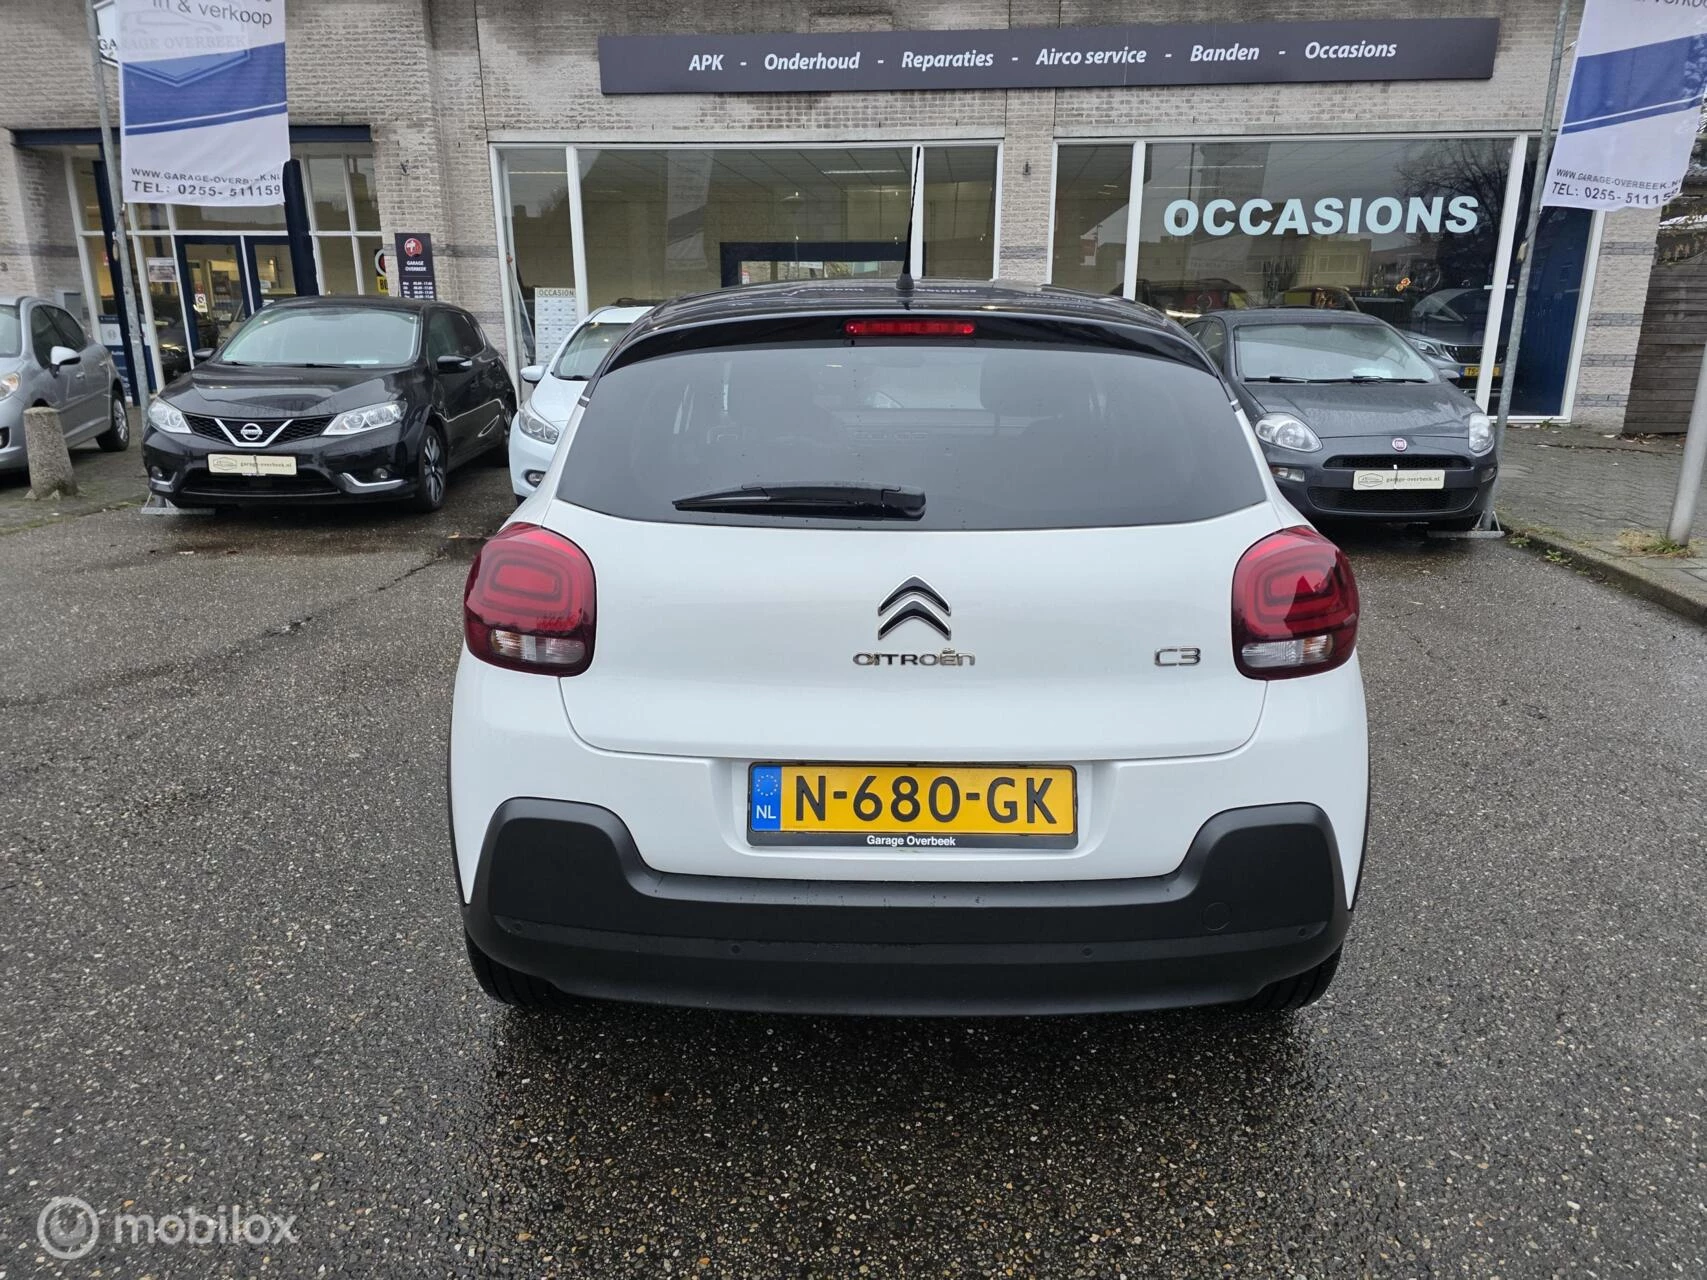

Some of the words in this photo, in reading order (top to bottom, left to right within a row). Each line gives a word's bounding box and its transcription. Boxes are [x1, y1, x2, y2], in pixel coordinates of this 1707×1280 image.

[199, 4, 272, 27] verkoop
[688, 54, 725, 71] APK
[764, 51, 861, 71] Onderhoud
[901, 49, 994, 72] Reparaties
[1035, 47, 1082, 66] Airco
[1084, 45, 1147, 65] service
[1189, 42, 1260, 62] Banden
[1304, 39, 1398, 59] Occasions
[131, 168, 280, 185] WWW.GARAGE-OVERBK.NL
[131, 180, 170, 193] TEL:
[178, 184, 223, 196] 0255-
[229, 184, 281, 197] 511159
[1552, 181, 1579, 196] TEL:
[1584, 187, 1621, 201] 0255-
[1163, 195, 1479, 237] OCCASIONS
[539, 289, 574, 297] OCCASION
[1154, 647, 1201, 667] C3
[756, 805, 777, 819] NL
[795, 775, 1058, 824] N-680-GK
[866, 835, 905, 848] Garage
[906, 835, 956, 846] Overbeek
